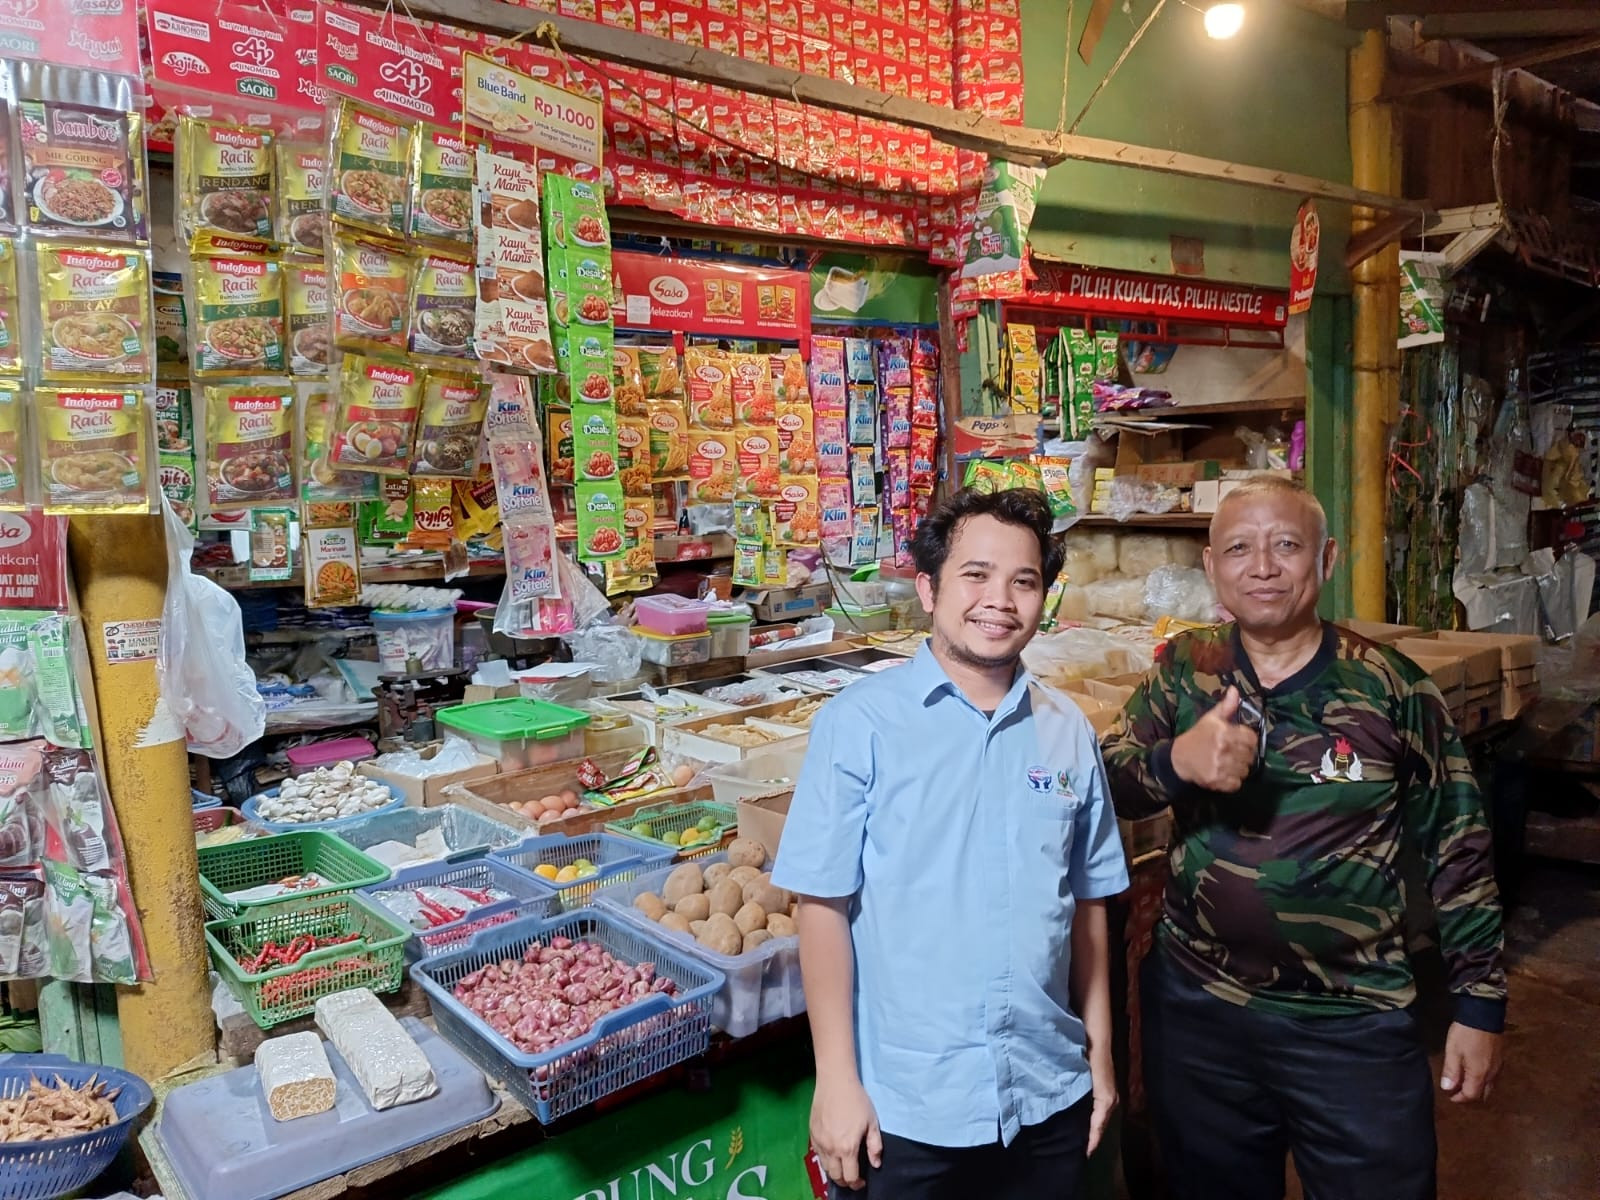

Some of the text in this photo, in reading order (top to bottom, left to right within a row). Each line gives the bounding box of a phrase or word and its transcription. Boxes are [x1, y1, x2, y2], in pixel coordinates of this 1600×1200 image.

[0, 39, 35, 52] AORI
[367, 33, 380, 44] Eat
[167, 53, 208, 76] Sajiku
[328, 69, 355, 84] SAORI
[240, 83, 273, 97] SAORI
[375, 90, 434, 116] AJINOMOTO
[535, 96, 595, 130] Rp 1.000
[53, 109, 117, 142] bamboe
[358, 115, 395, 135] Indofood
[215, 132, 257, 147] Indofood
[361, 133, 390, 150] Racik
[220, 150, 255, 165] Racik
[440, 153, 469, 167] Racik
[494, 164, 521, 180] Kayu
[202, 177, 268, 188] RENDANG
[494, 178, 527, 193] Manis
[499, 235, 526, 252] Kayu
[66, 255, 119, 269] Indofood
[359, 252, 389, 266] Racik
[500, 250, 533, 264] Manis
[216, 262, 261, 274] Indofood
[432, 259, 470, 272] Indofood
[222, 279, 258, 293] Racik
[436, 273, 465, 286] Racik
[654, 281, 685, 299] Sasa
[1070, 274, 1111, 299] PILIH
[1113, 278, 1183, 310] KUALITAS,
[1184, 289, 1218, 308] PILIH
[1220, 292, 1262, 315] NESTLE
[505, 307, 533, 322] Kayu
[508, 320, 539, 334] Manis
[371, 369, 410, 383] Indofood
[820, 373, 841, 386] Klin
[373, 386, 403, 399] Racik
[64, 397, 118, 409] Indofood
[234, 400, 276, 410] Indofood
[498, 402, 520, 412] Klin
[71, 413, 113, 430] Racik
[239, 414, 273, 430] Racik
[855, 415, 872, 425] Klin
[822, 445, 843, 456] Klin
[513, 486, 535, 496] Klin
[824, 509, 847, 521] Klin
[0, 523, 23, 538] sa
[16, 574, 39, 585] DARI
[524, 569, 546, 580] Klin
[5, 587, 34, 598] ALAMI
